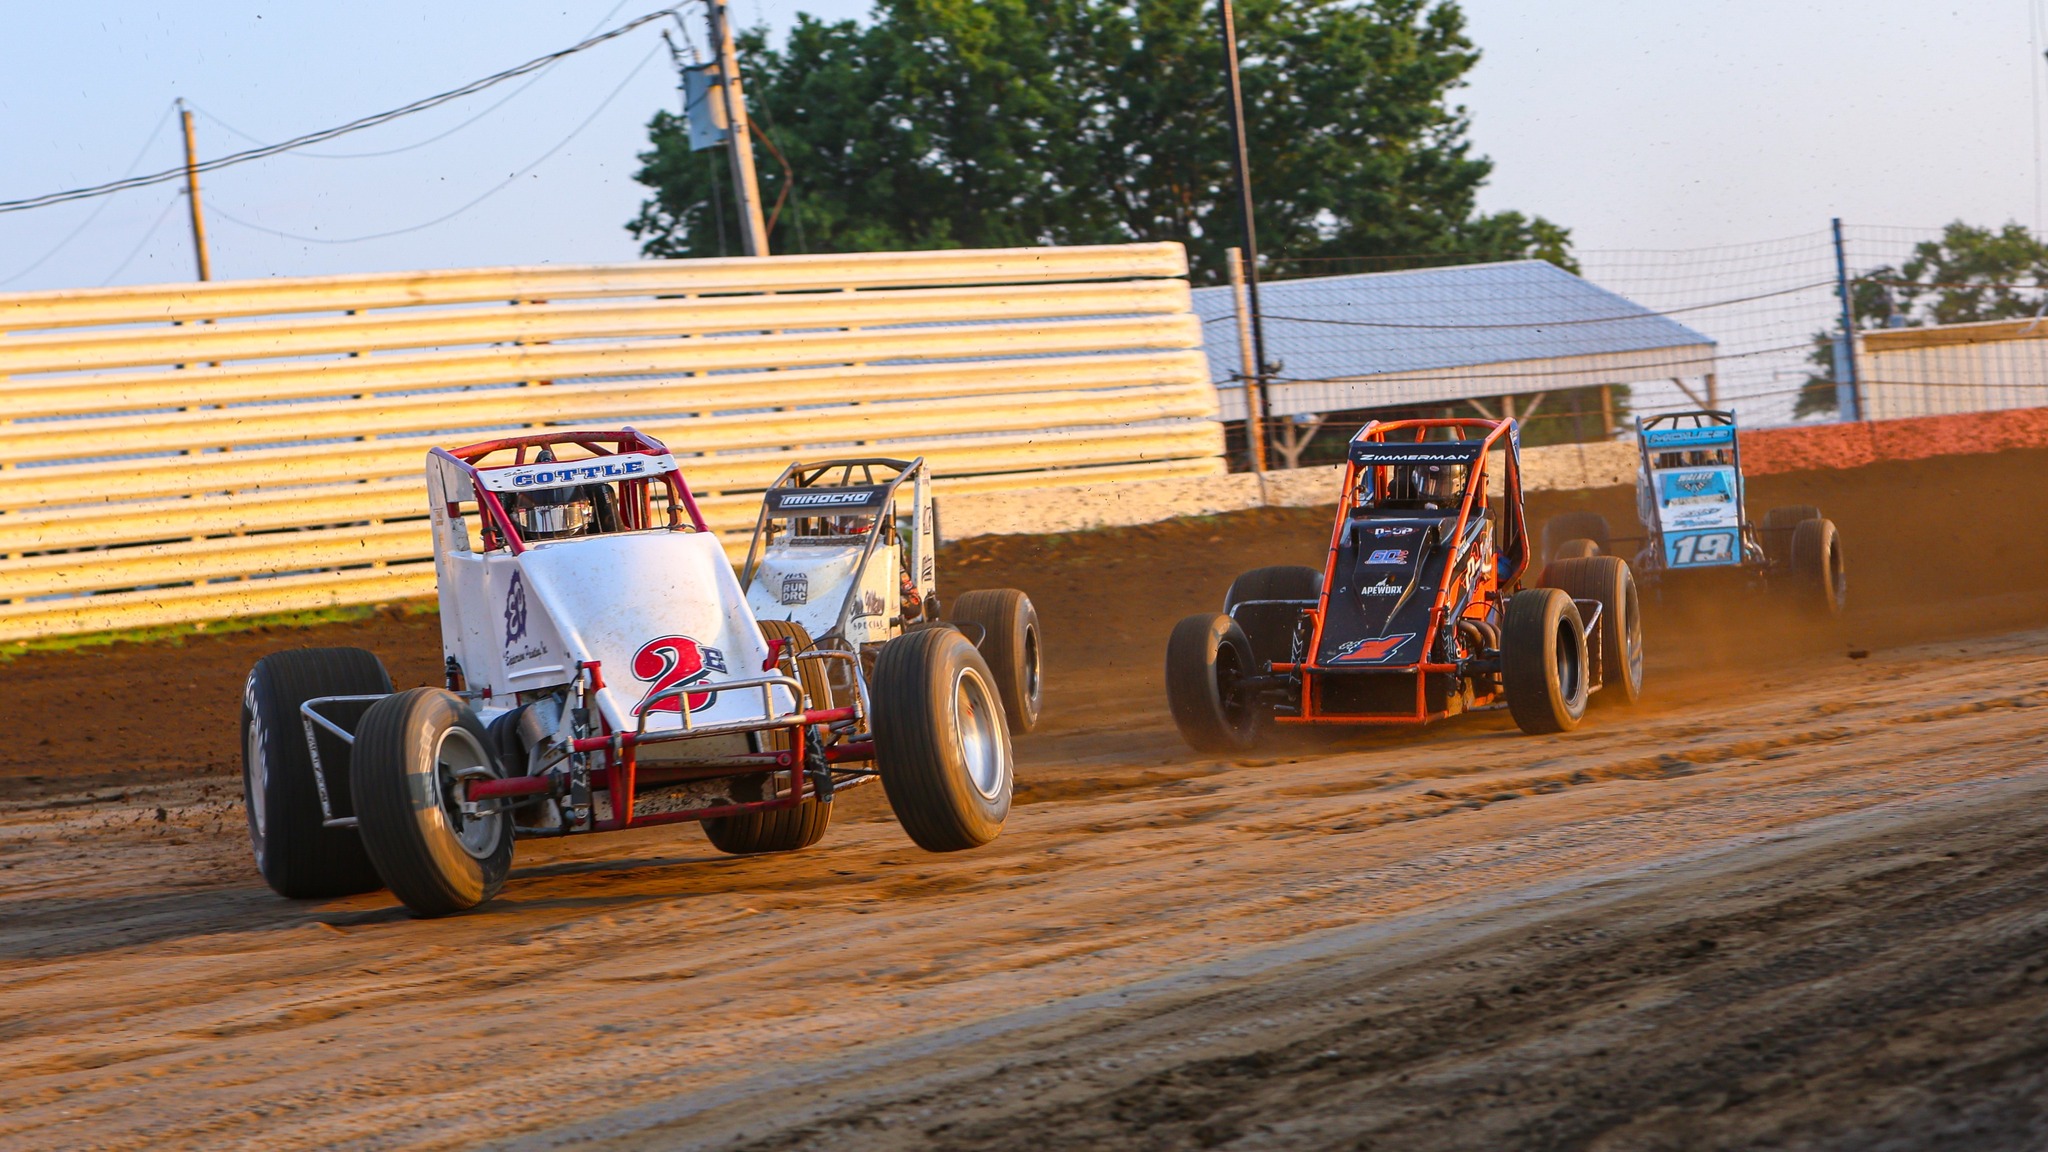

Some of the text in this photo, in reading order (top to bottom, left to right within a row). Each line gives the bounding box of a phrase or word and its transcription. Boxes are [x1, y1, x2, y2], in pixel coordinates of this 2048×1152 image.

[513, 461, 644, 487] COTTLE
[784, 493, 868, 505] MIHOCKO
[1673, 533, 1734, 565] 19
[783, 583, 807, 593] RUN
[1361, 586, 1402, 595] APEWORX
[783, 592, 806, 602] DRC
